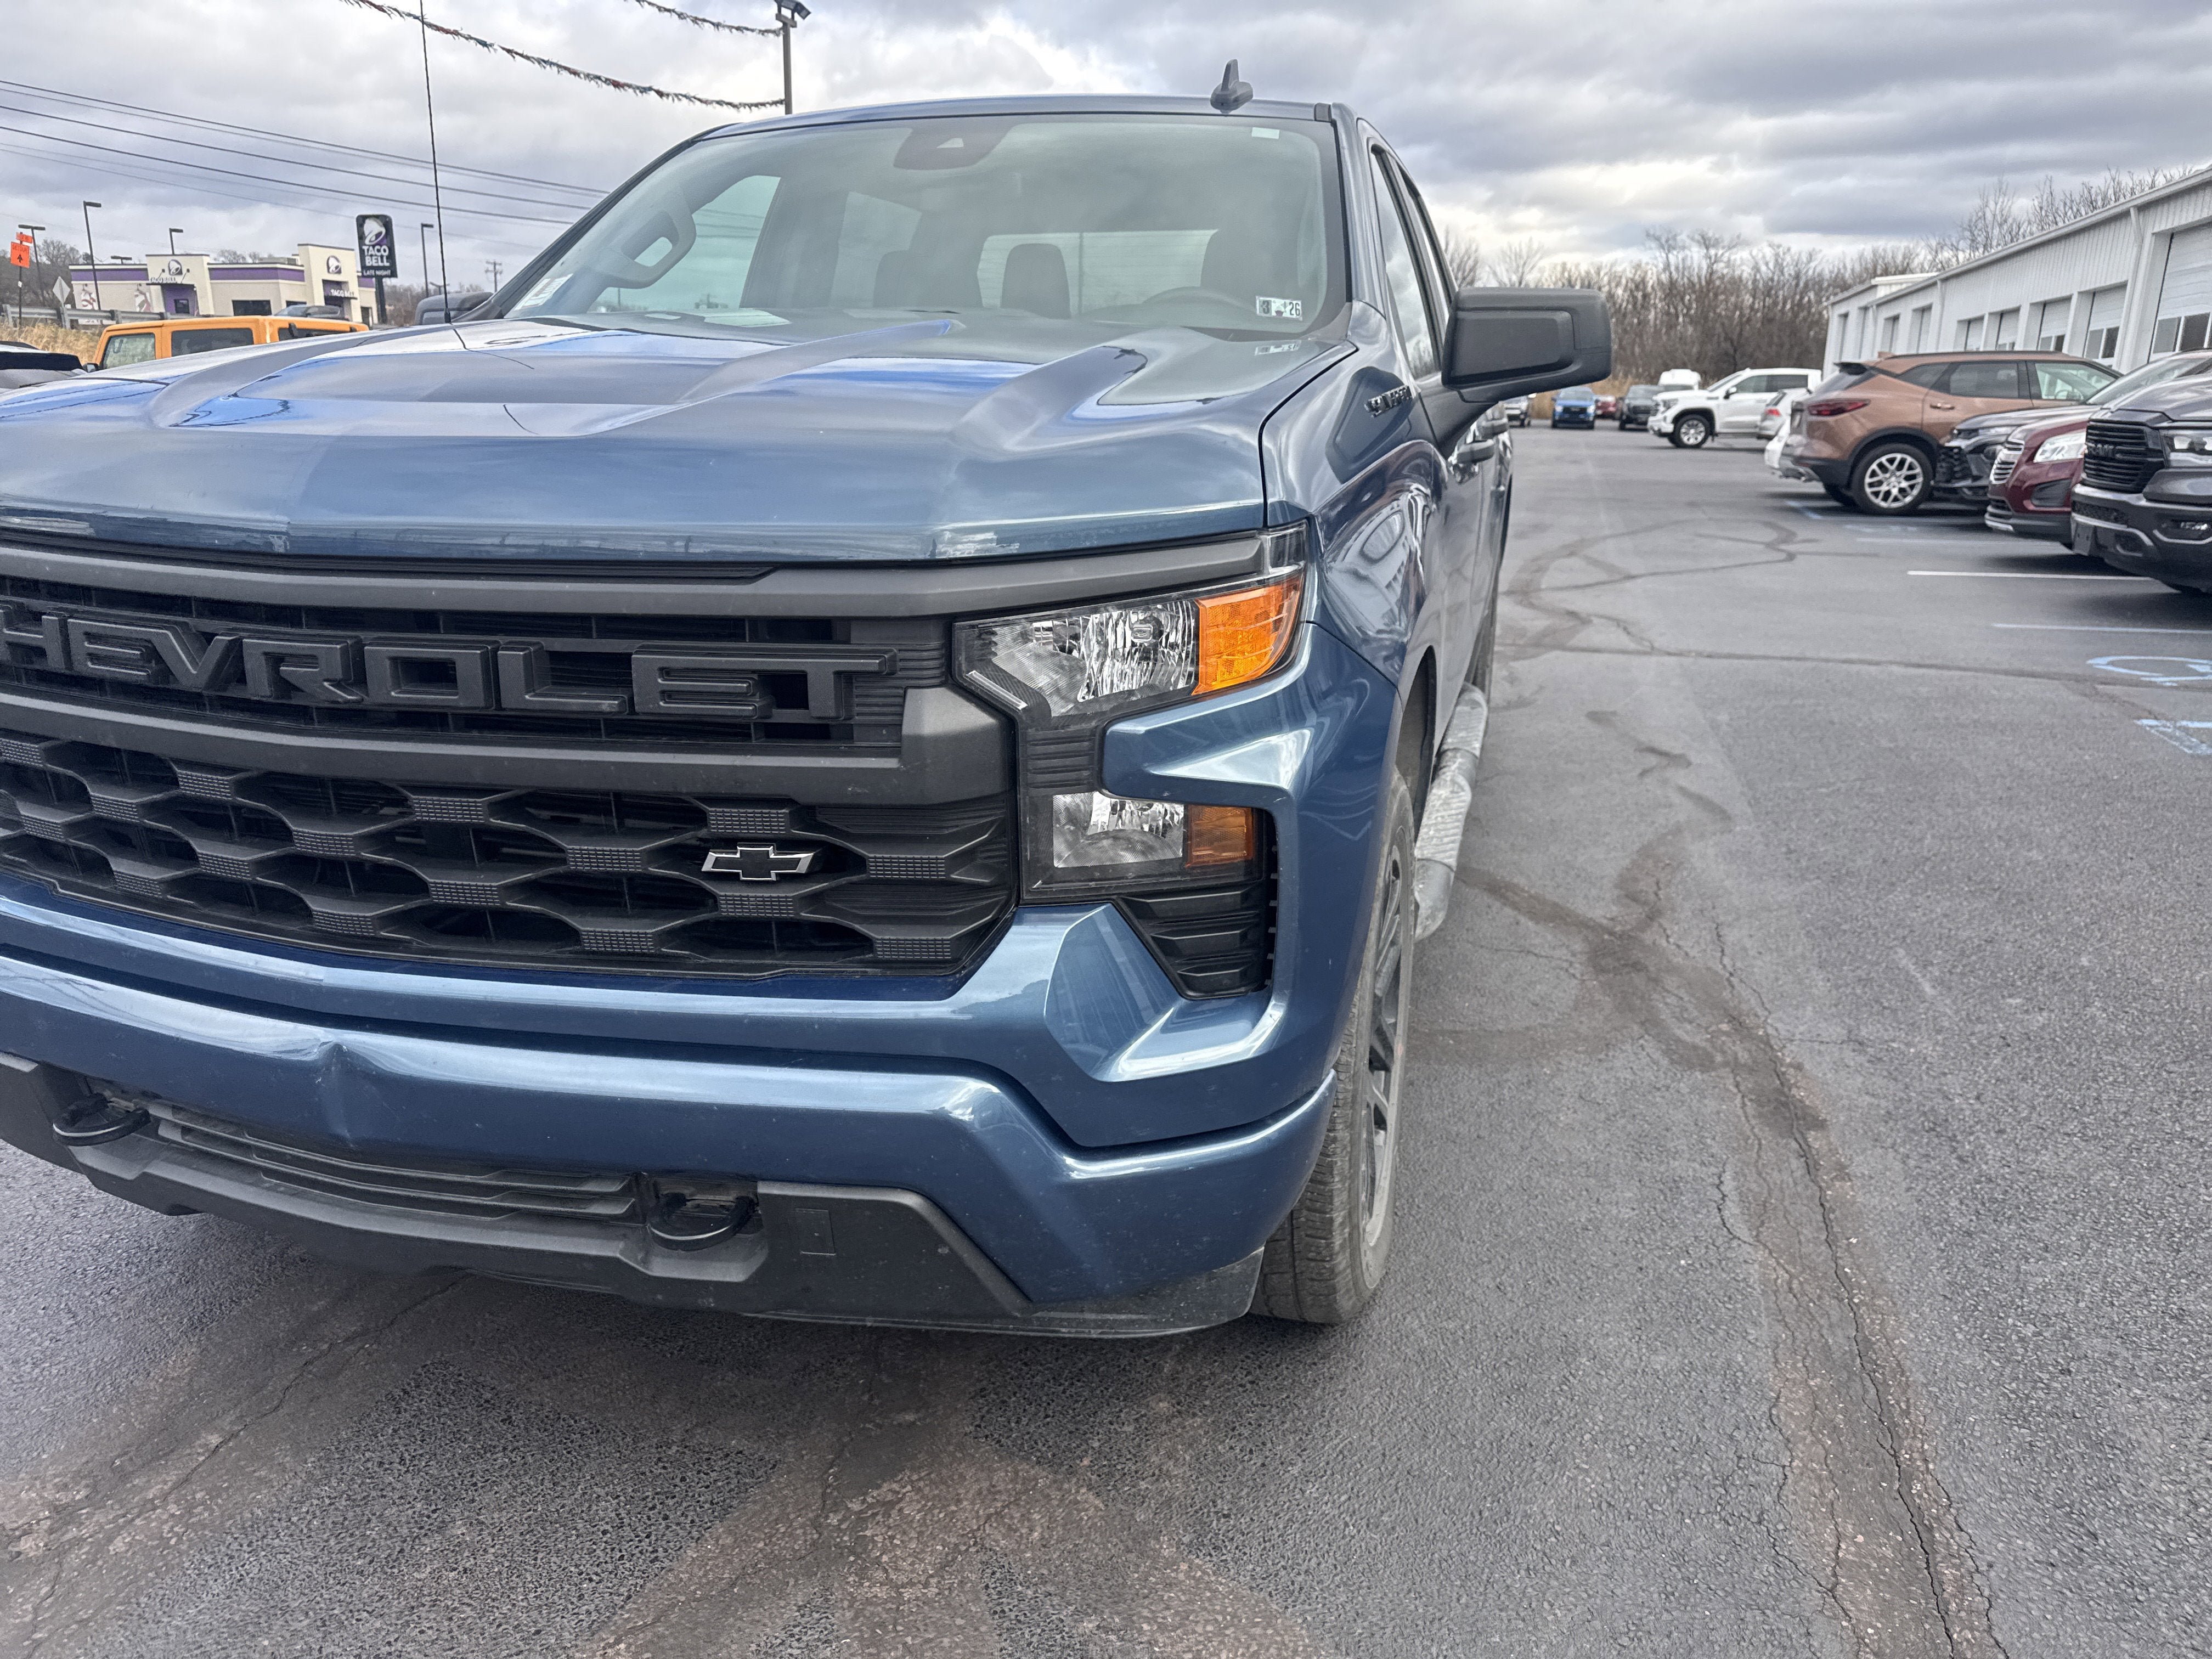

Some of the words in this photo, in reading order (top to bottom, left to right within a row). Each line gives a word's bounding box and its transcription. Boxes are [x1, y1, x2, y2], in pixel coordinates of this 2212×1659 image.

[362, 245, 389, 256] TACO
[365, 256, 390, 266] BELL
[1262, 300, 1270, 314] 3
[1289, 302, 1300, 316] 26
